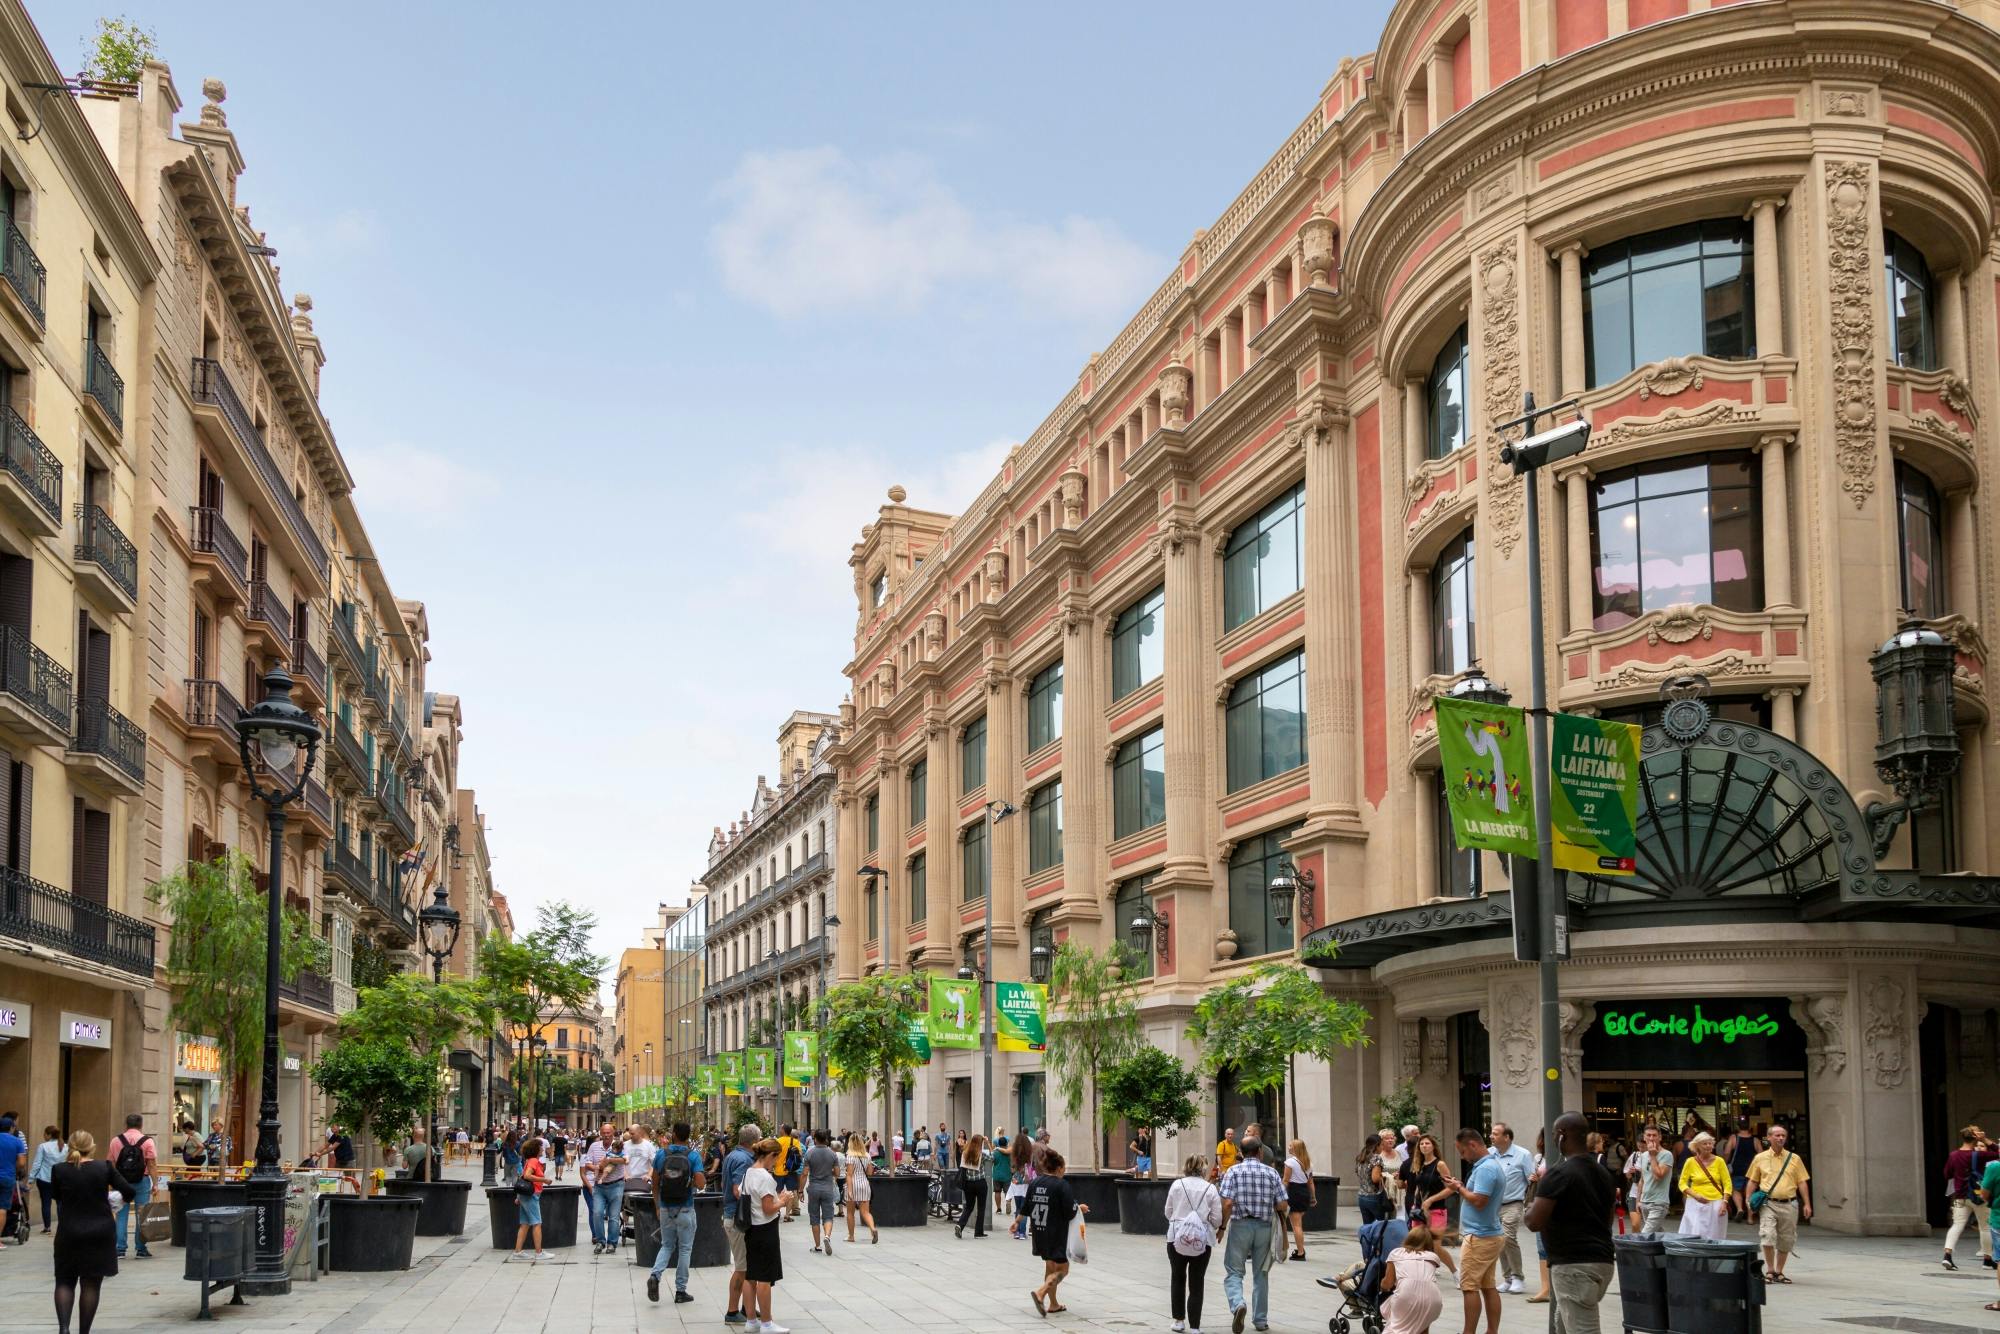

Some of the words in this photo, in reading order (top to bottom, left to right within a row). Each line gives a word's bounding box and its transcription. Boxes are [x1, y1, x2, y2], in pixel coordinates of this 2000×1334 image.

[1573, 734, 1590, 753] LA
[1594, 737, 1617, 757] VIA
[1561, 755, 1627, 780] LAIETANA
[1583, 803, 1595, 814] 22
[1464, 818, 1480, 834] LA
[1009, 990, 1019, 999] LA
[1020, 990, 1035, 1000] VIA
[1003, 1000, 1040, 1010] LAIETANA
[73, 1022, 101, 1040] pimkie
[1603, 1011, 1629, 1036] El
[1629, 1012, 1689, 1036] Corte
[1691, 1004, 1779, 1043] Inglés
[1035, 1187, 1047, 1195] NEW
[1031, 1203, 1049, 1226] 47
